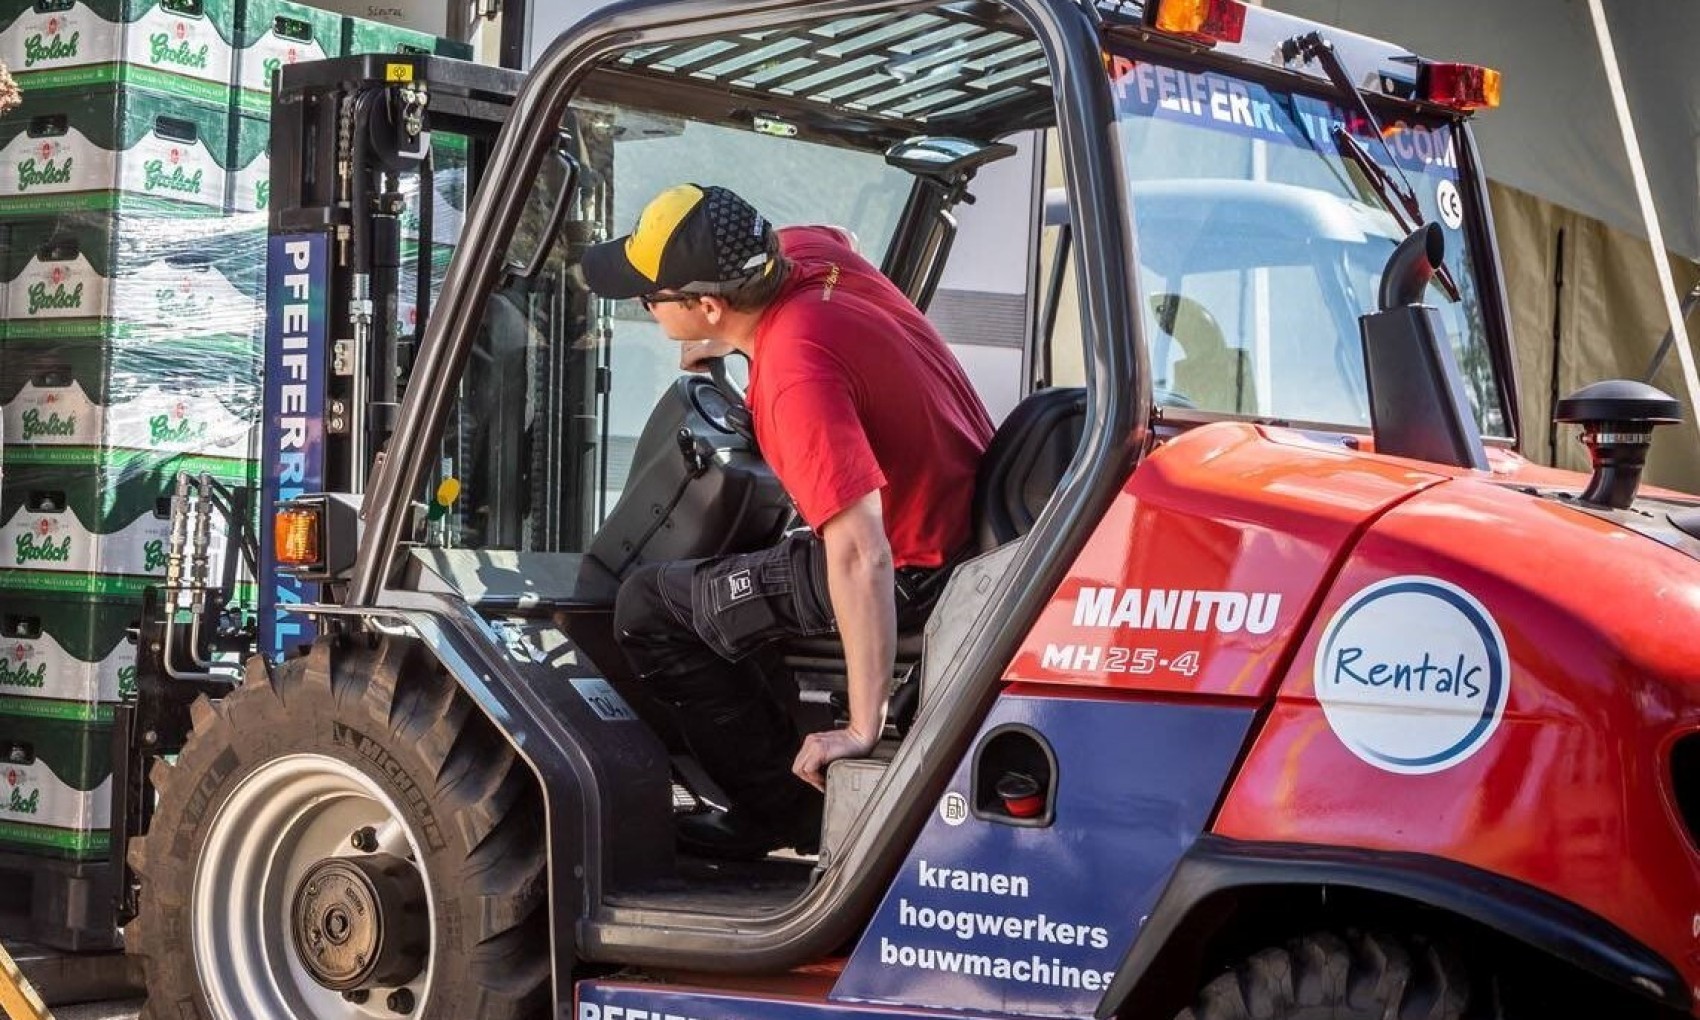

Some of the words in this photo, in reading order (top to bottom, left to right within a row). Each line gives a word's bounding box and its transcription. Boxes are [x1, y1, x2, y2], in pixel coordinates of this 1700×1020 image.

[24, 31, 80, 67] Grolsch
[150, 32, 208, 68] Grolsch
[18, 157, 72, 190] Grolsch
[144, 159, 203, 195] Grolsch
[28, 281, 83, 315] Grolsch
[16, 532, 71, 565] Grolsch
[1072, 586, 1282, 634] MANITOU
[1334, 647, 1482, 699] Rentals
[918, 860, 1030, 898] kranen
[899, 898, 1110, 949] hoogwerkers
[880, 937, 1117, 992] bouwmachines
